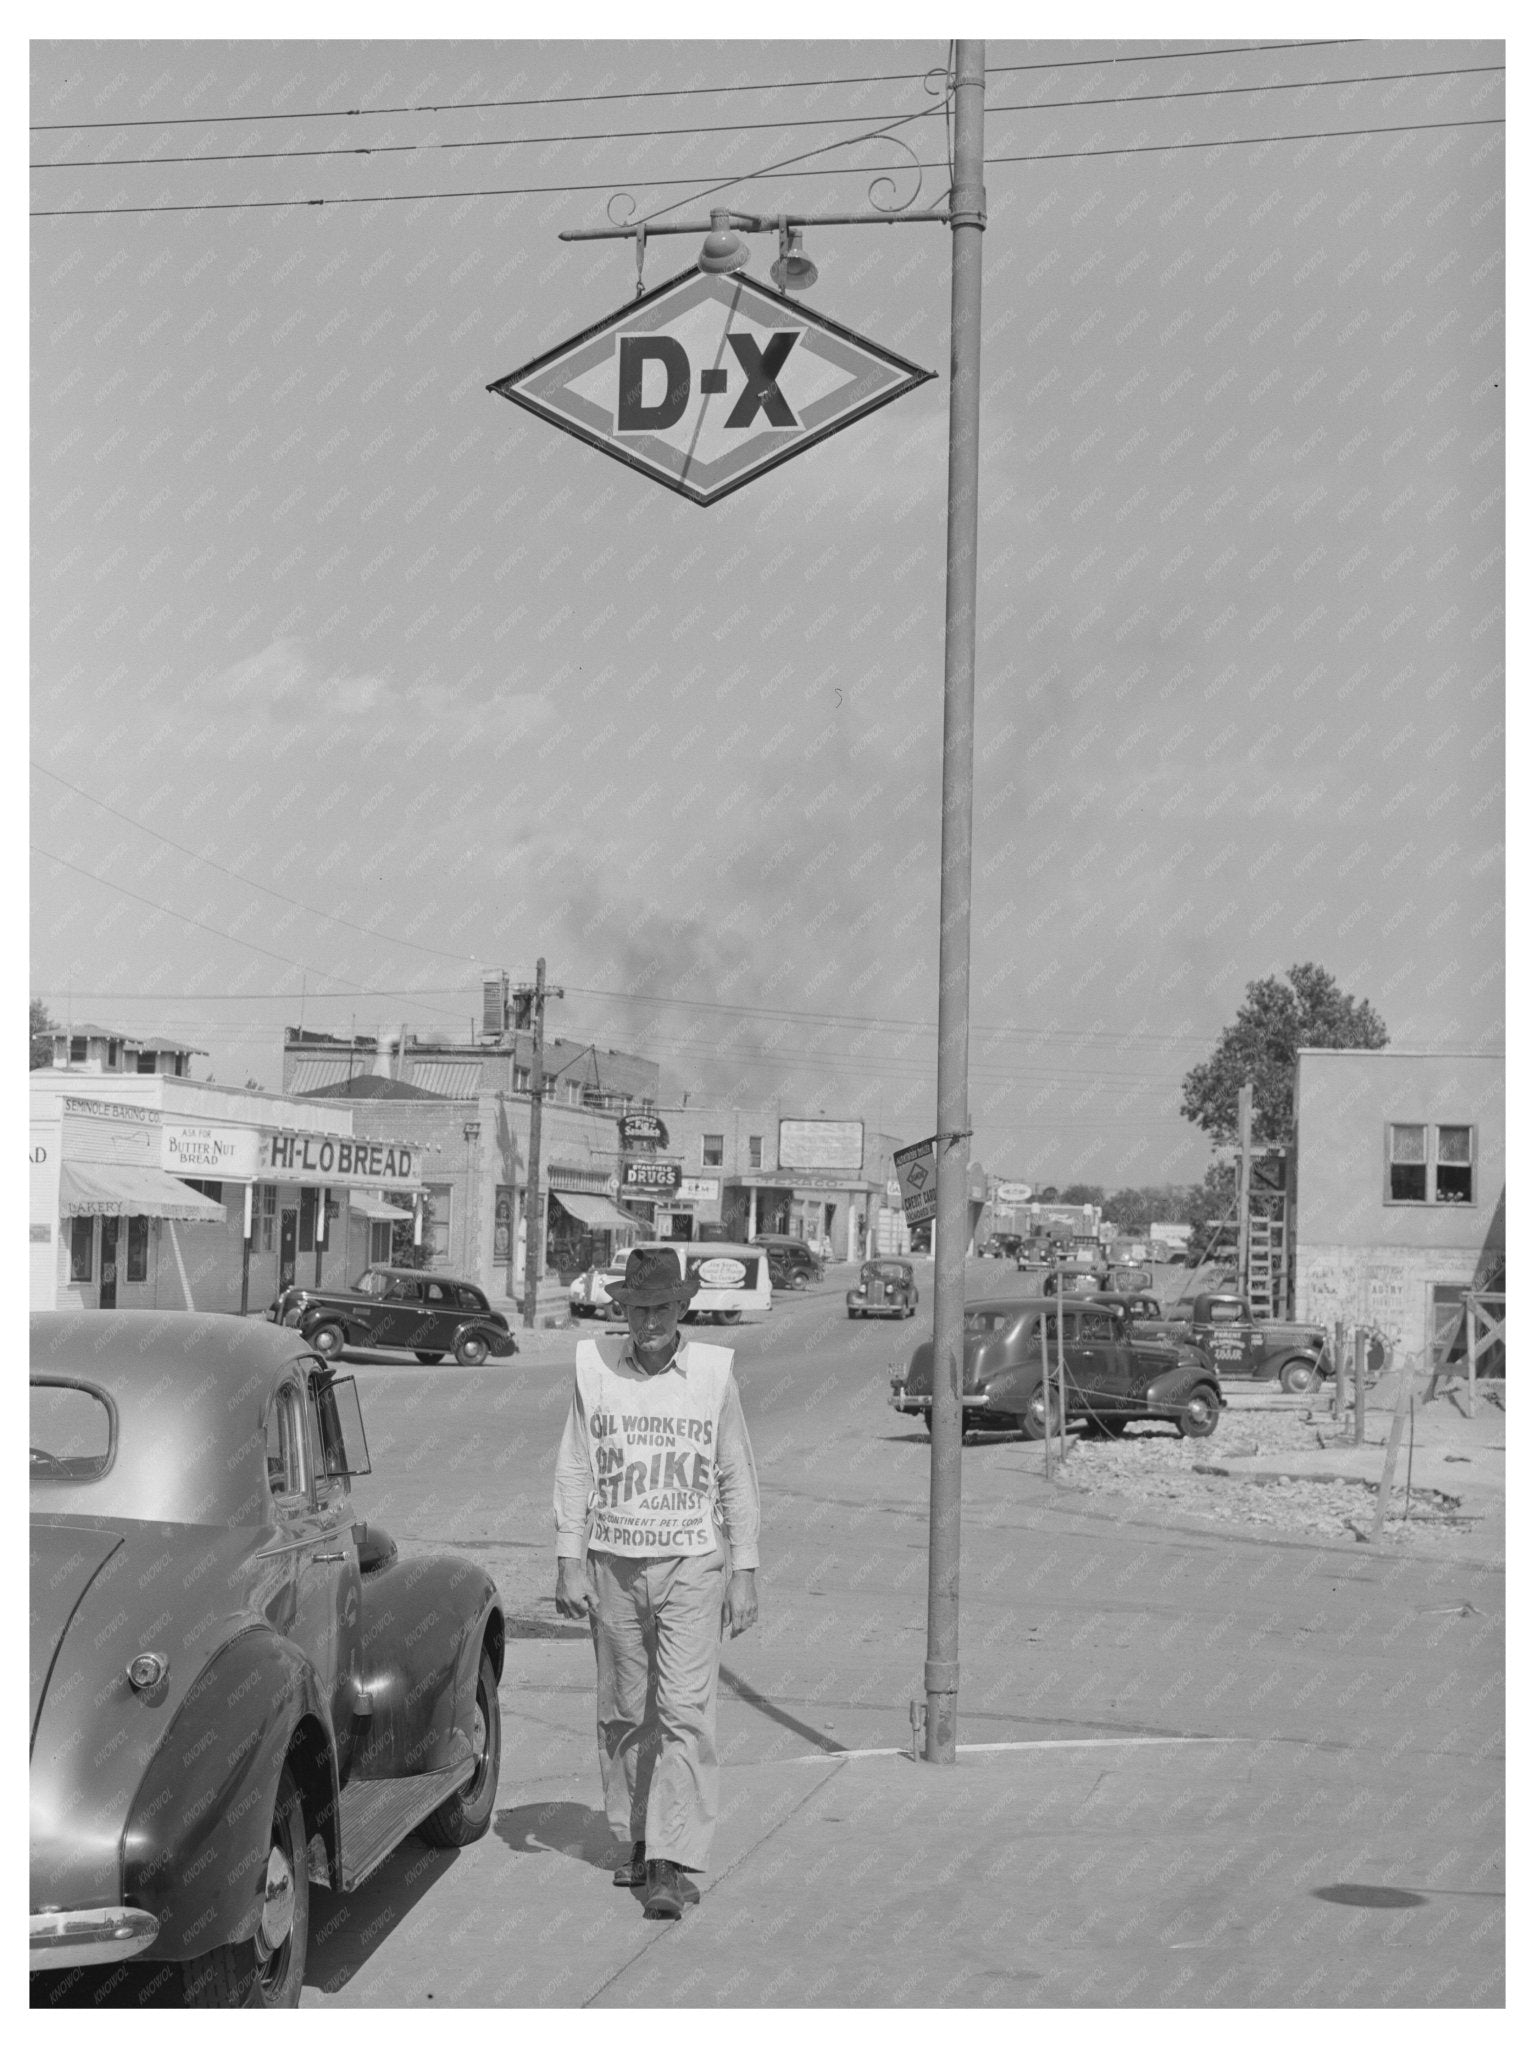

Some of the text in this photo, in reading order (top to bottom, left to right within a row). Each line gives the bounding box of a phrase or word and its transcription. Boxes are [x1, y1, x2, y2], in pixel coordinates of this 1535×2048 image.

[618, 331, 801, 431] D-X
[65, 1099, 111, 1117] SEMINOLE
[112, 1106, 146, 1121] BAKING
[179, 1153, 219, 1165] BREAD
[271, 1136, 413, 1178] HI-LO BREAD
[627, 1169, 677, 1185] DRUGS
[68, 1200, 124, 1214] BAKERY
[589, 1413, 713, 1446] OIL WORKERS
[626, 1433, 676, 1447] UNION
[595, 1446, 624, 1475] ON
[597, 1451, 711, 1509] STRIKE
[638, 1492, 704, 1511] AGAINST
[614, 1527, 709, 1547] PRODUCTS
